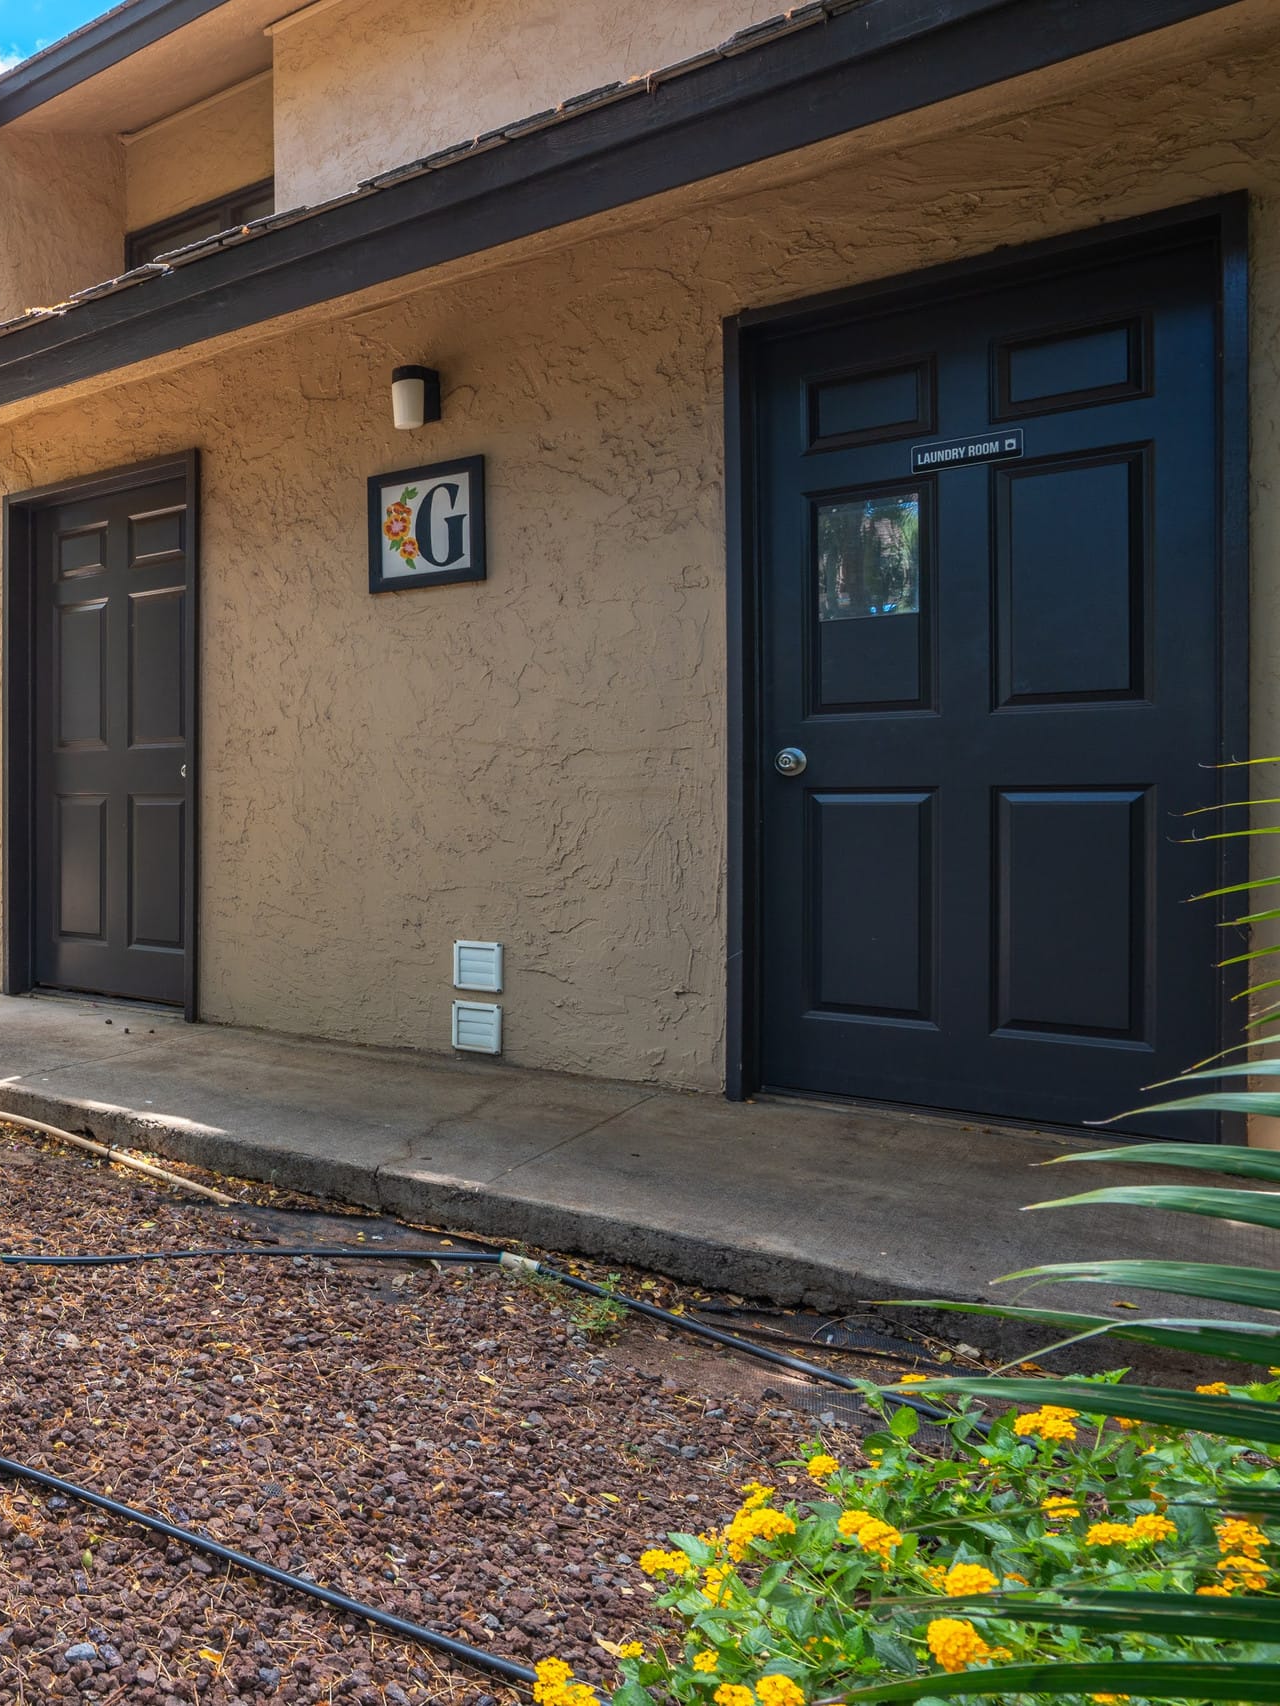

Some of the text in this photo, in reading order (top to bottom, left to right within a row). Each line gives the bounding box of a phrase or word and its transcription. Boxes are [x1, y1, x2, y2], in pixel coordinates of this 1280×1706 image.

[917, 440, 1000, 465] LAUNDRY ROOM
[415, 482, 467, 567] G
